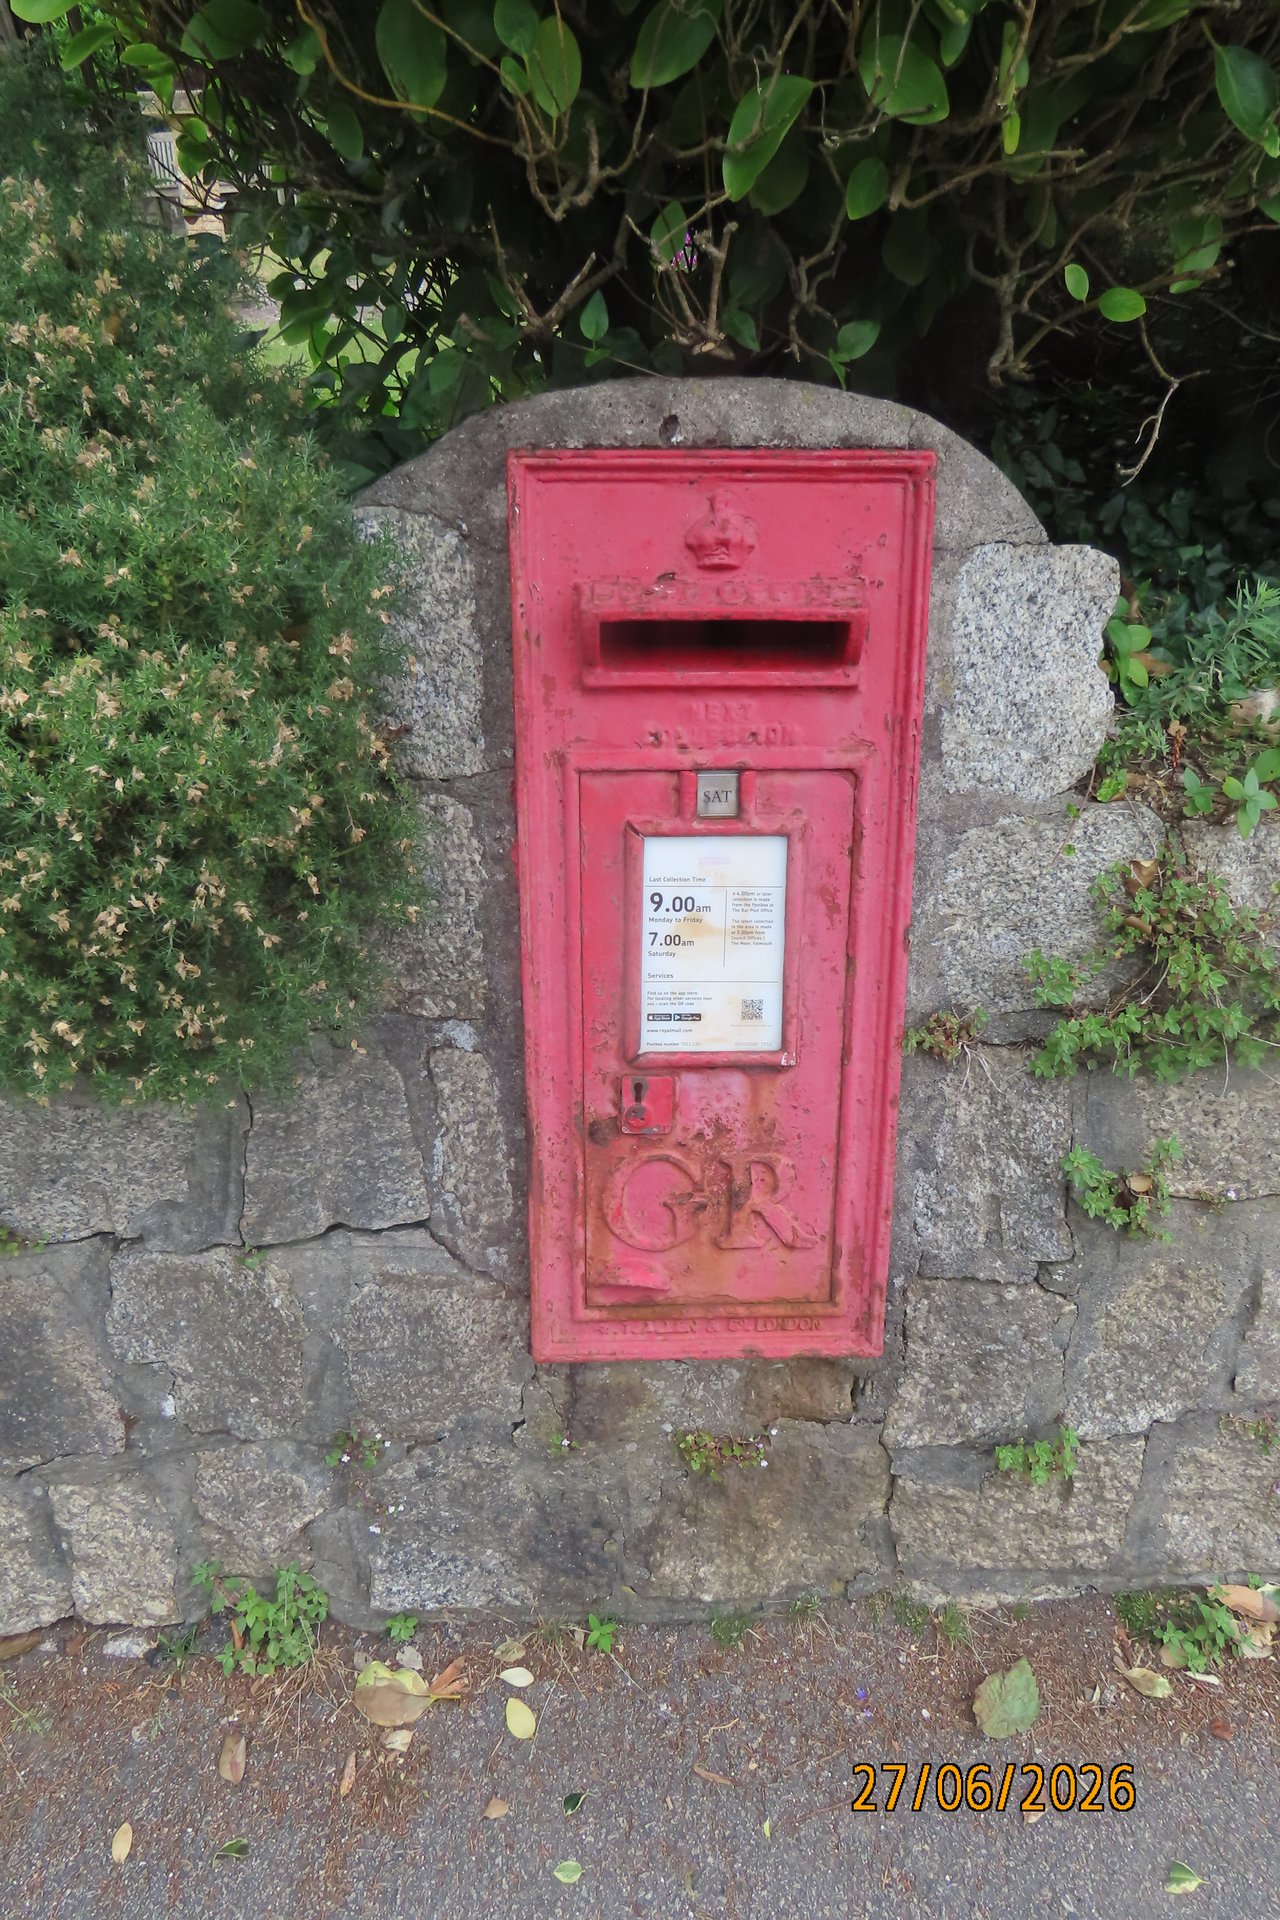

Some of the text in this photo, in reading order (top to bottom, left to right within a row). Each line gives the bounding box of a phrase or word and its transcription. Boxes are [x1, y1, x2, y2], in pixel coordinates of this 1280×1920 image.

[703, 790, 732, 803] SAT
[650, 892, 712, 912] 9.00am
[648, 932, 694, 946] 7.00am
[602, 1153, 820, 1251] GR
[755, 1317, 822, 1332] LONDON
